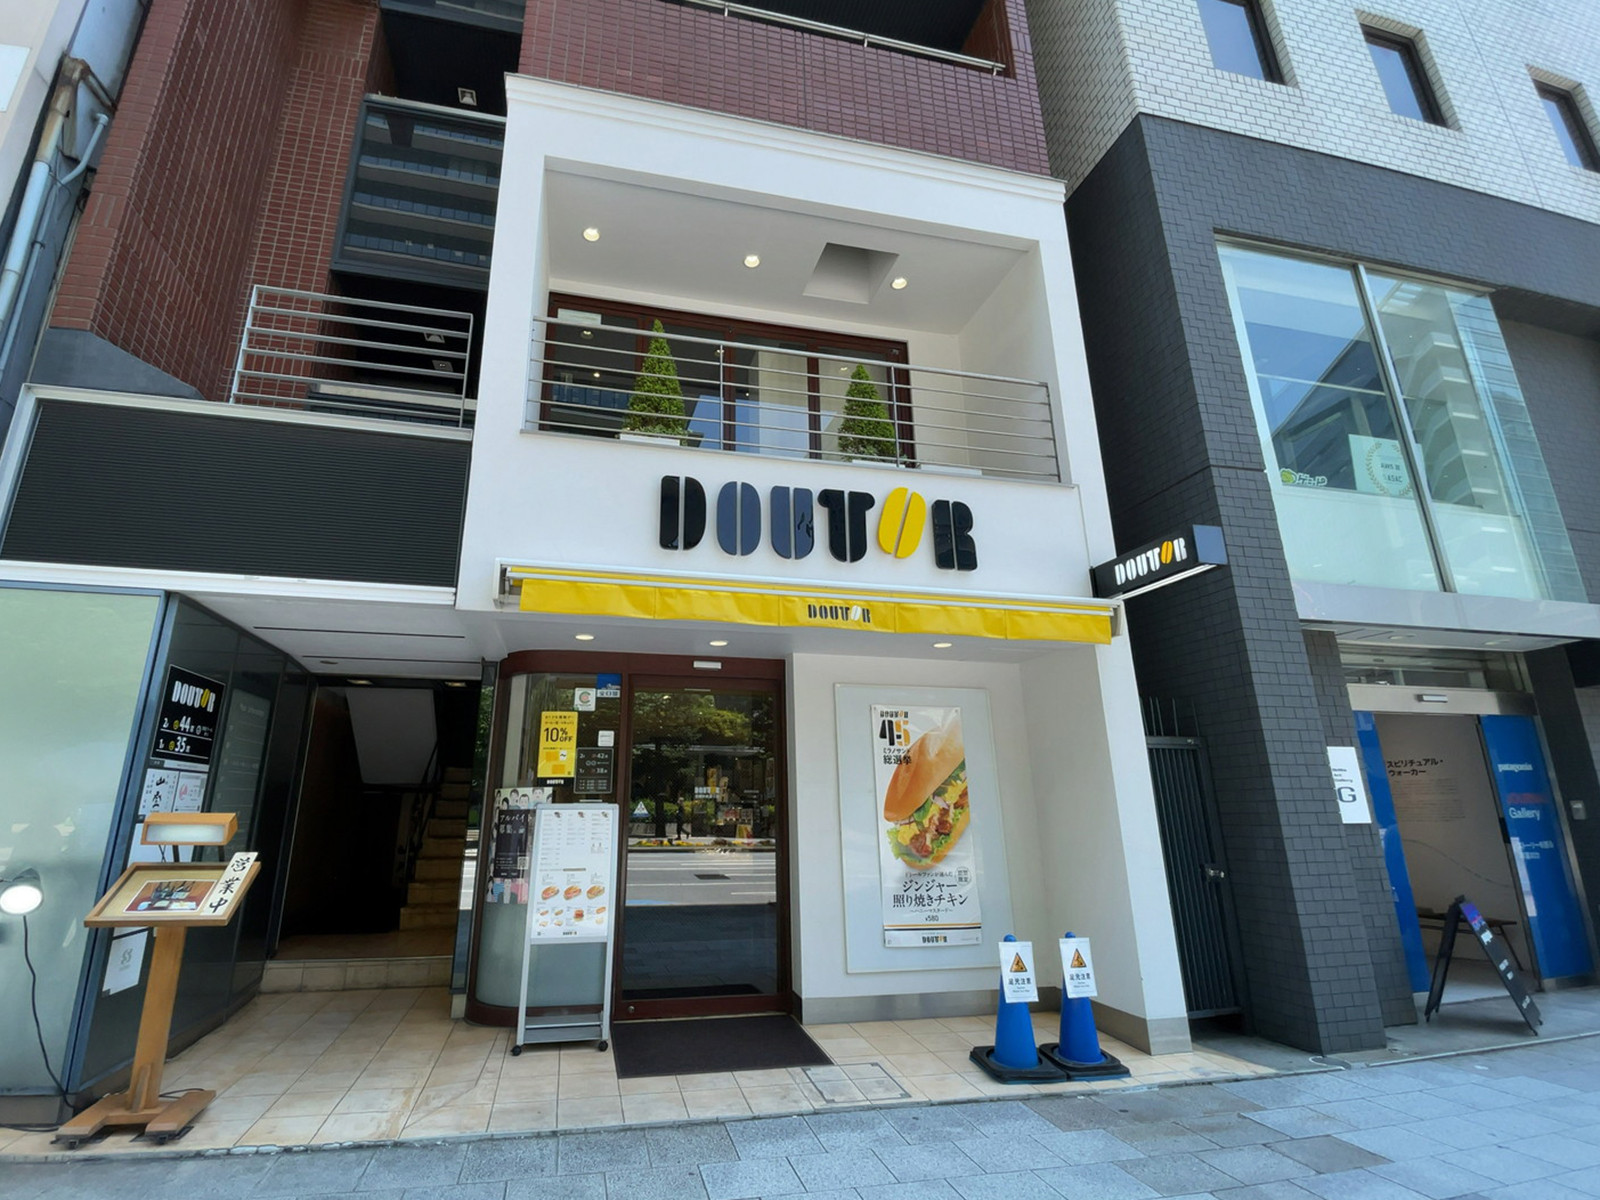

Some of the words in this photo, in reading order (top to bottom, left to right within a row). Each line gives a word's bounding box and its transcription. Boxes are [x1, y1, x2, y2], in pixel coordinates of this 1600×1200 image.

[659, 475, 978, 571] DOUTOR
[1114, 537, 1188, 586] DOUTOR
[808, 604, 871, 623] DOUTOR
[172, 681, 216, 713] DOUTOR
[879, 719, 911, 747] 45
[883, 755, 912, 765] 総選挙
[1388, 769, 1427, 777] ウォーカー
[1508, 807, 1540, 821] Gallery
[209, 857, 251, 913] 営業中
[903, 879, 957, 893] ジンジャー
[893, 893, 968, 908] 照り焼きチキン
